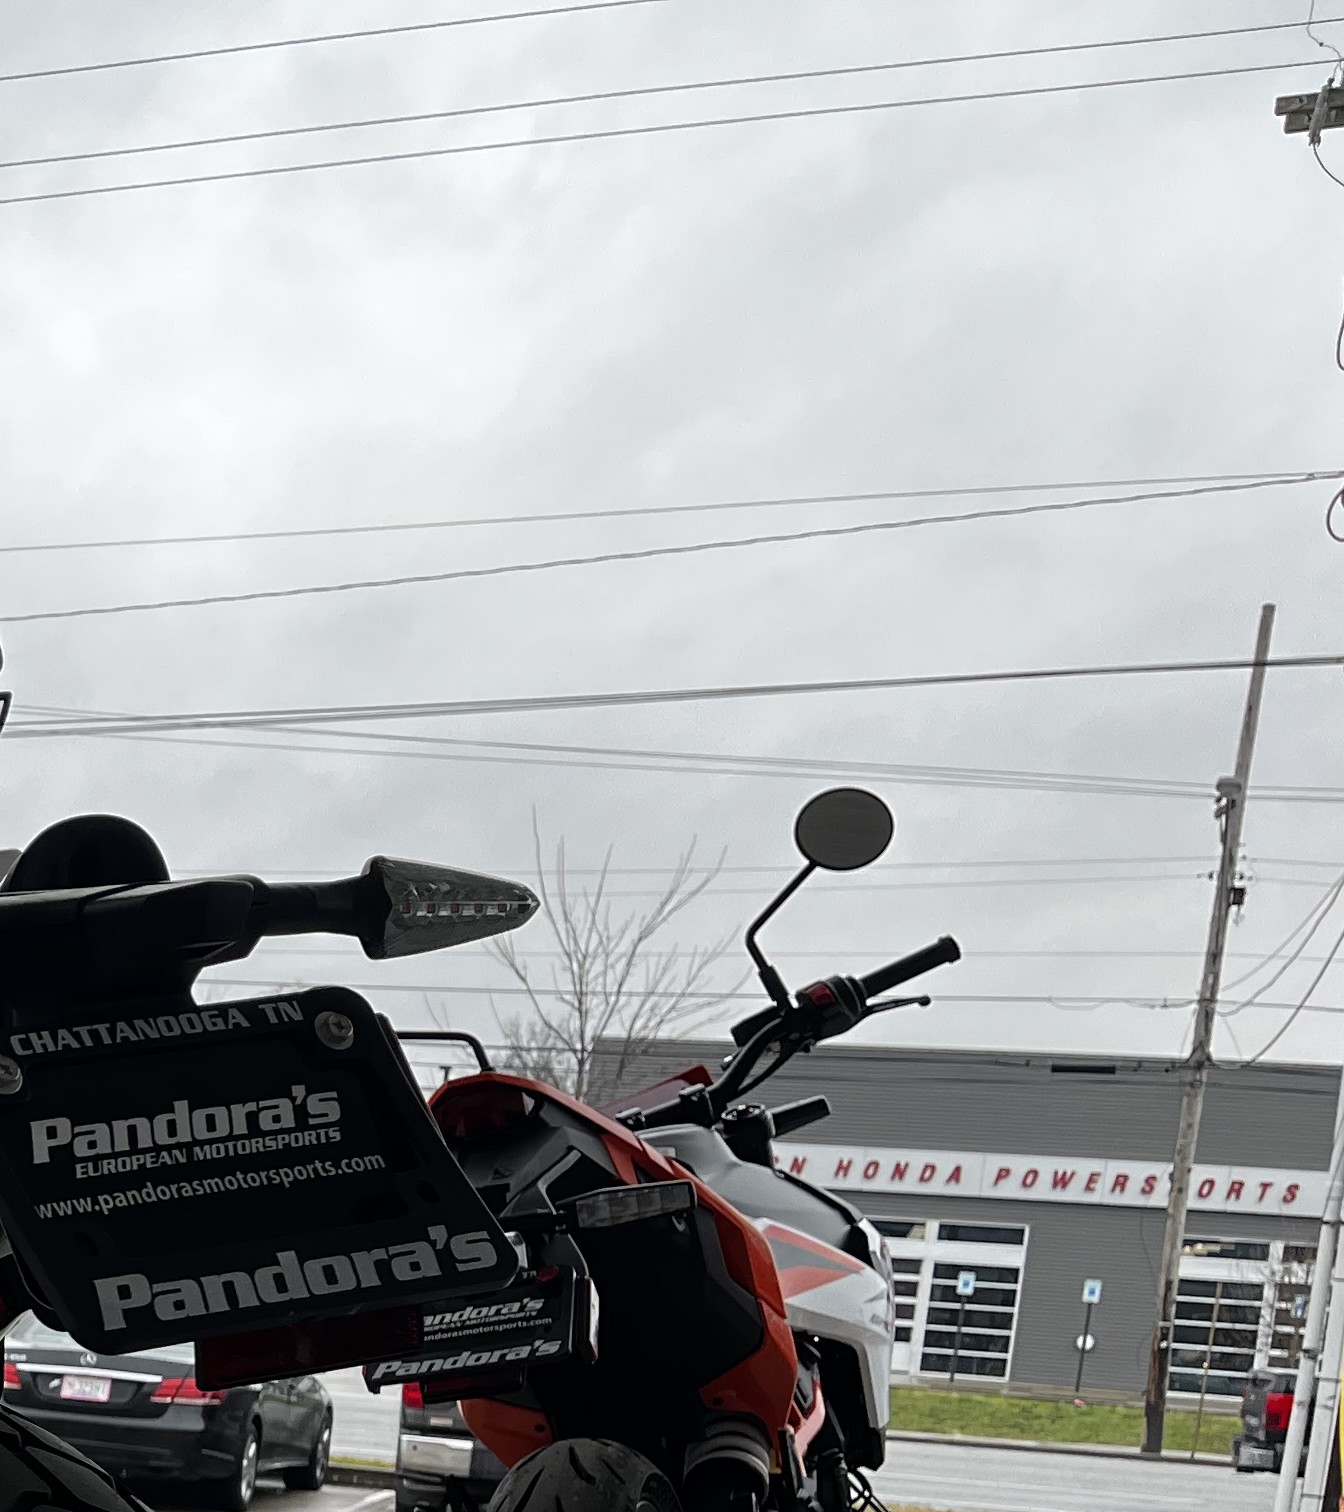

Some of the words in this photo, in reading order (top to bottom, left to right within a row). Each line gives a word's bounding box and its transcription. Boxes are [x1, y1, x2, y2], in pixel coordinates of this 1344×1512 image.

[9, 1006, 249, 1057] CHATTANOOGA
[259, 1001, 304, 1025] TN
[29, 1084, 341, 1164] Pandora's
[75, 1147, 187, 1179] EUROPEAN
[192, 1126, 341, 1162] MOTORSPORTS
[33, 1151, 386, 1220] www.pandorasmotorsports.com
[834, 1158, 962, 1185] HONDA
[993, 1167, 1301, 1204] POWERSORTS
[92, 1225, 498, 1331] Pandora's
[423, 1297, 545, 1325] ndora's
[424, 1318, 552, 1342] ndorasmotorsports.com
[373, 1338, 562, 1380] Pandora's
